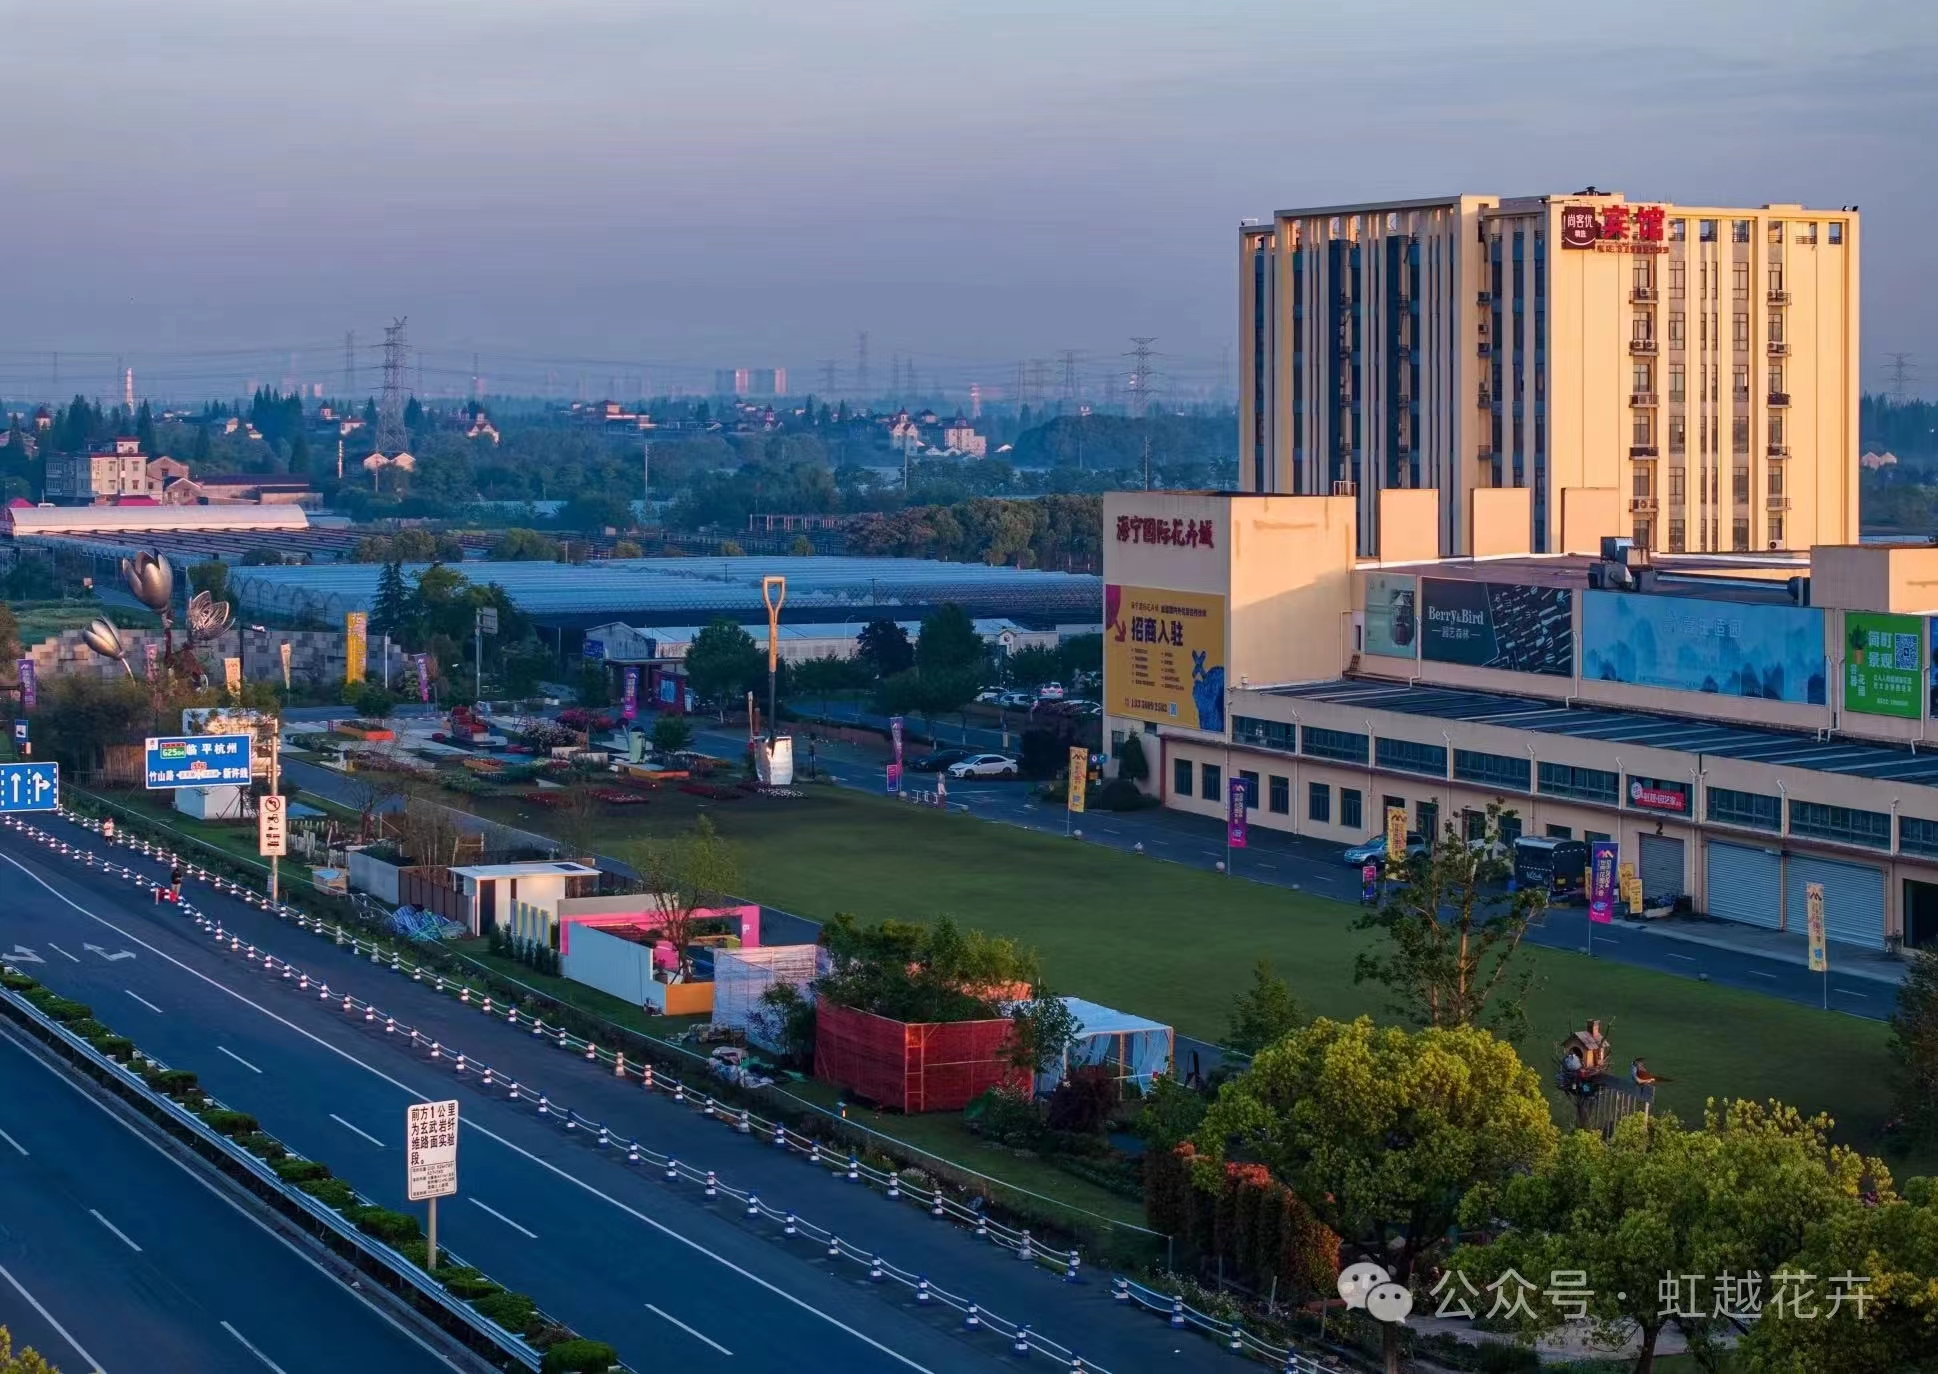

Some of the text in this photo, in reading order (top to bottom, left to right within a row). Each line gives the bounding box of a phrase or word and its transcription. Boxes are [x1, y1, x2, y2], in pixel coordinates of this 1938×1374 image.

[1567, 214, 1593, 228] 尚客优
[1602, 205, 1665, 241] 宾馆
[1116, 514, 1215, 549] 海宁国际花卉城
[1428, 605, 1484, 625] Berry&Bird
[1131, 615, 1184, 647] 招商入驻
[1868, 651, 1893, 669] 景观
[149, 770, 174, 782] 竹山路
[1656, 822, 1664, 835] 2
[411, 1103, 456, 1121] 前方1公里
[411, 1118, 456, 1137] 为玄武岩纤
[411, 1134, 455, 1151] 维路面实验
